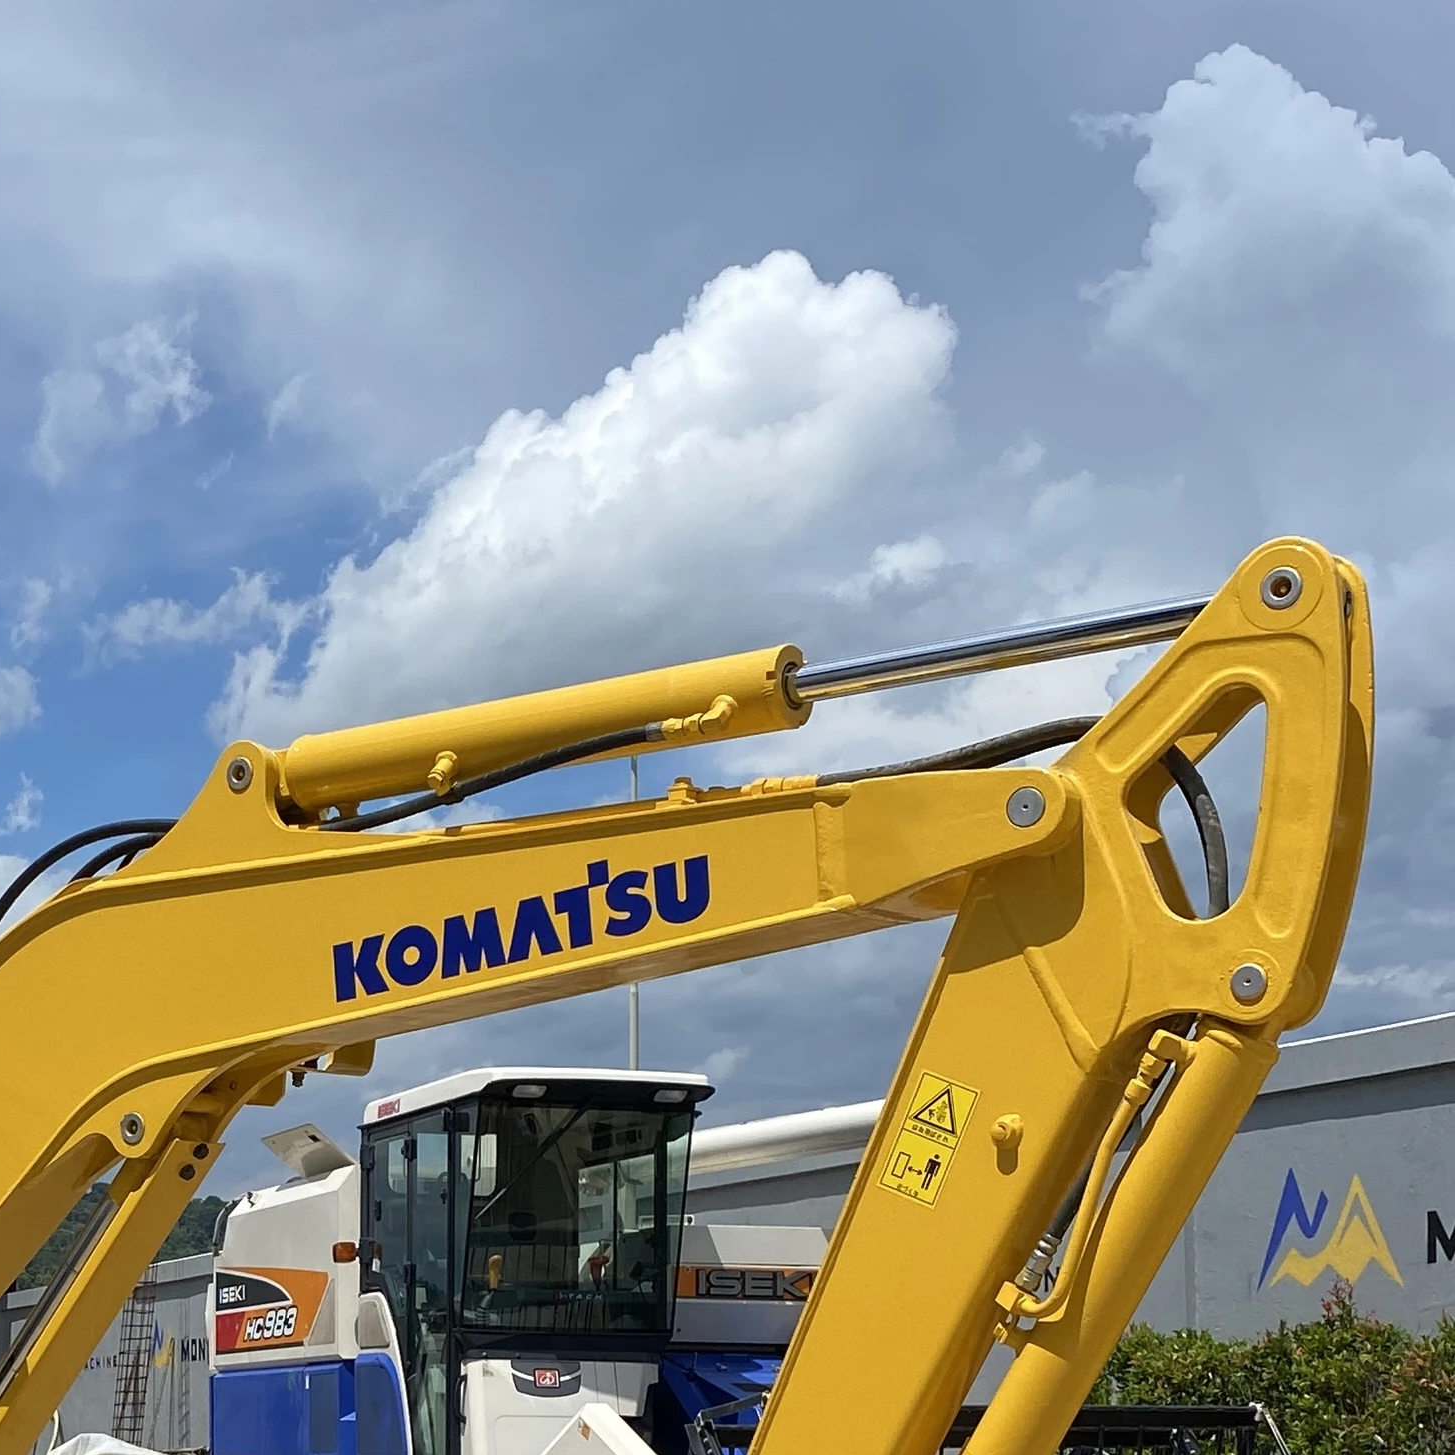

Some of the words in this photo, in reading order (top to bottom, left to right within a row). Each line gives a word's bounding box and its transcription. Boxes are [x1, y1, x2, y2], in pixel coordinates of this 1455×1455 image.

[333, 855, 709, 1003] KOMATSU
[219, 1284, 246, 1304] ISEKI
[698, 1269, 813, 1298] ISEK
[243, 1306, 298, 1342] HC983
